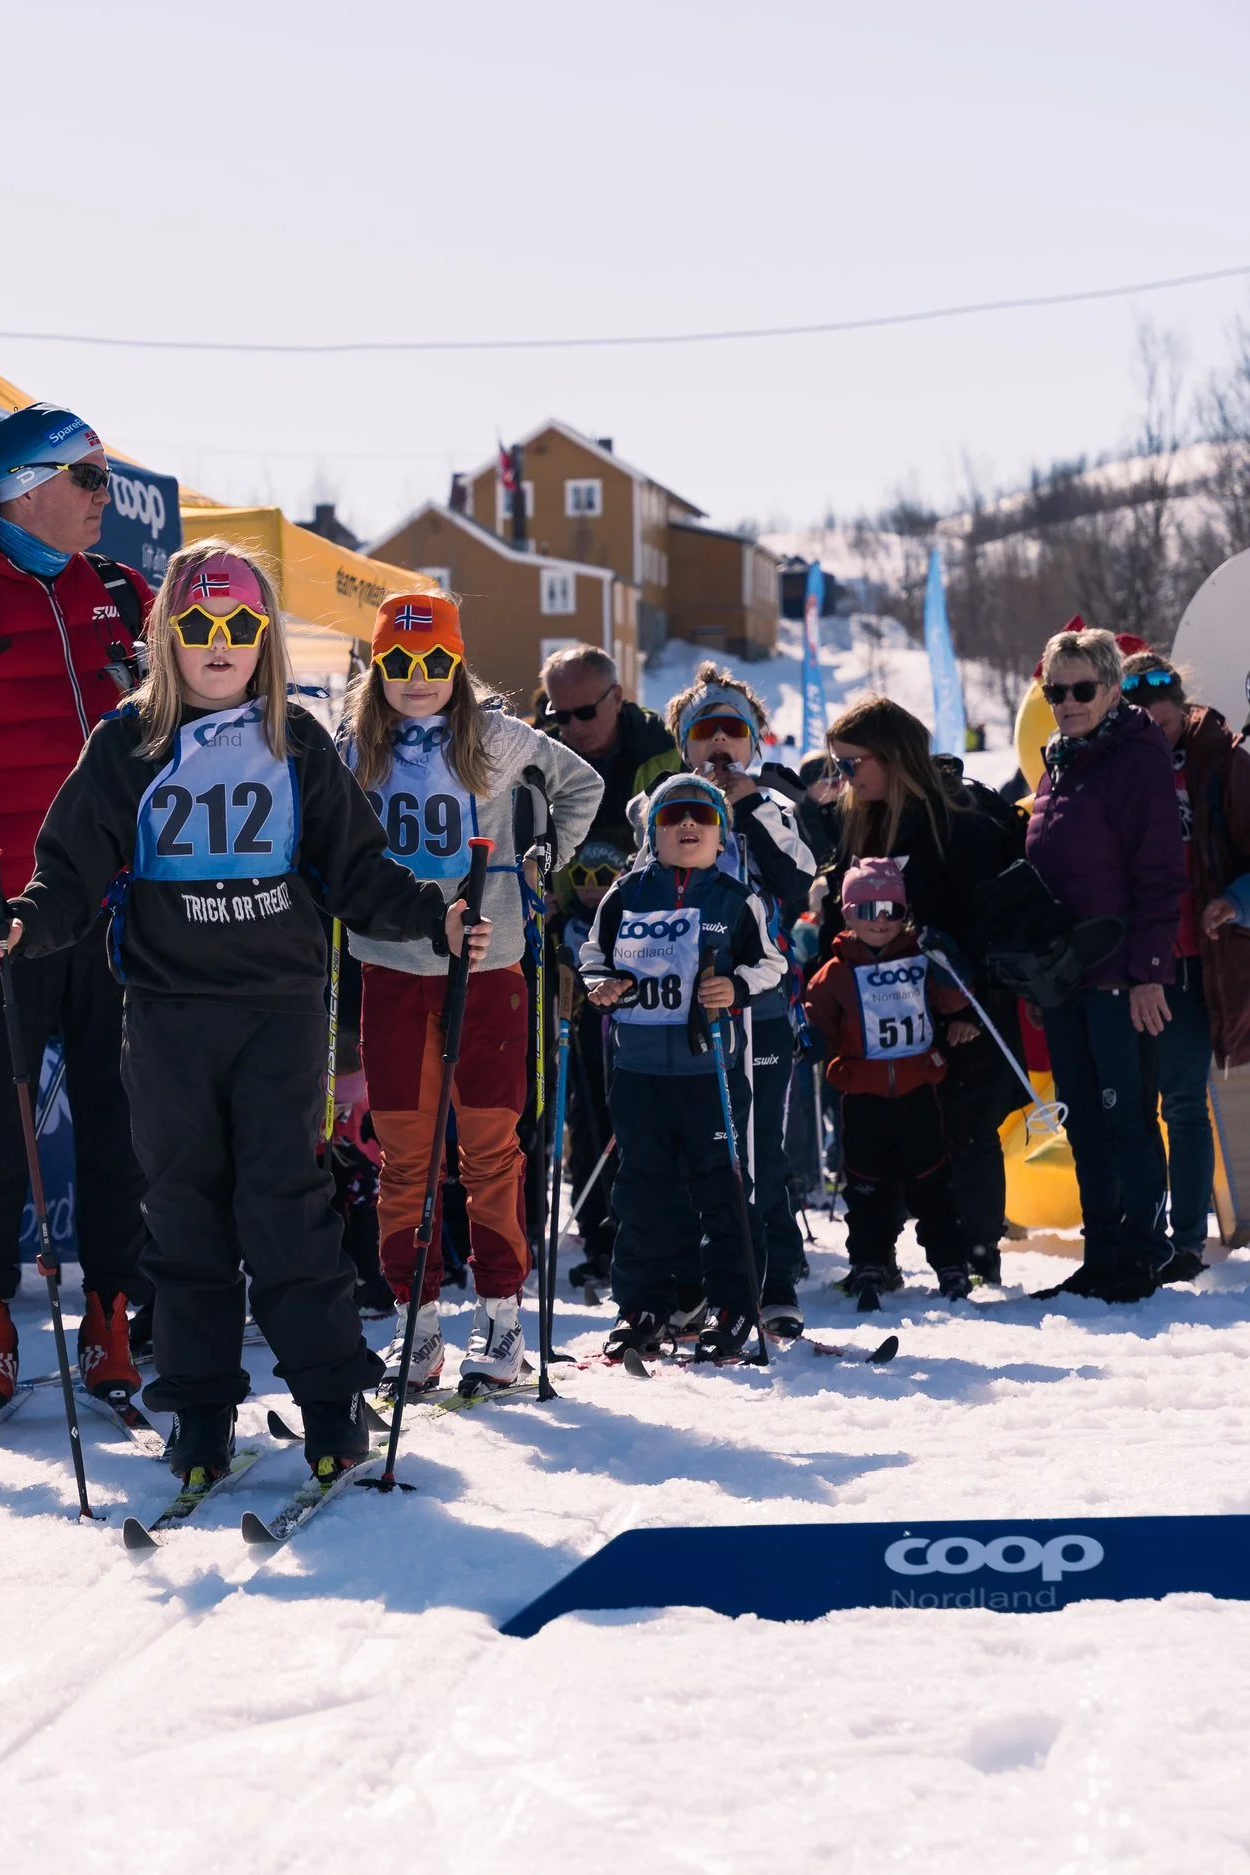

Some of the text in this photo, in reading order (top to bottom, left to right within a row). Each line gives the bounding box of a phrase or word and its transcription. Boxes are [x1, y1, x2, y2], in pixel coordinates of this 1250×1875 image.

[109, 471, 166, 540] coop
[150, 781, 274, 858] 212
[180, 893, 231, 924] TRICK
[231, 896, 257, 921] OR
[618, 918, 691, 942] coop
[614, 944, 675, 960] Nordland
[867, 965, 925, 987] coop
[884, 1534, 1105, 1582] coop
